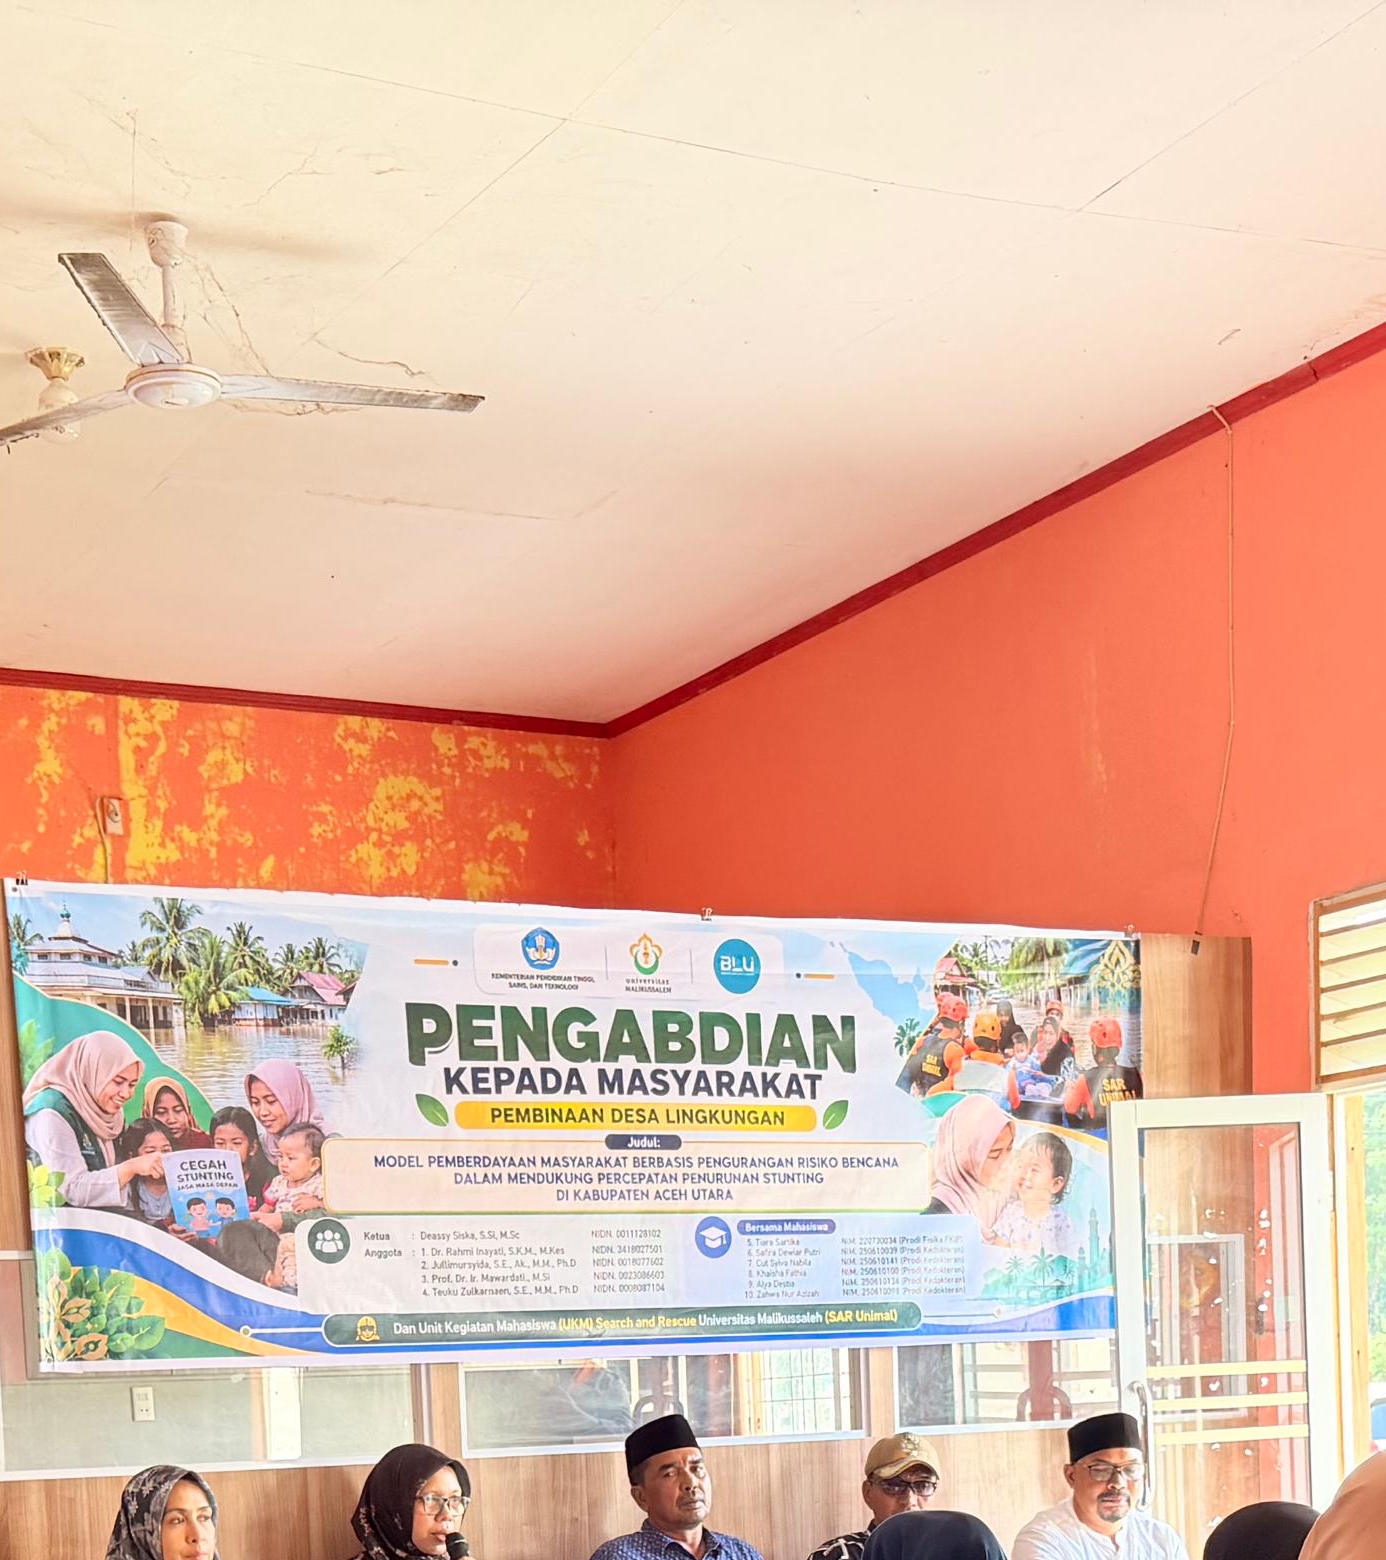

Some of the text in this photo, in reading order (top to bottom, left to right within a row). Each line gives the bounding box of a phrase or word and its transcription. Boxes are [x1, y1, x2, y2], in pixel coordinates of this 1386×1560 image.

[720, 955, 754, 973] BLU
[405, 1002, 857, 1073] PENGABDIAN
[444, 1066, 822, 1099] KEPADA MASYARAKAT
[1103, 1078, 1126, 1091] SAR
[491, 1108, 785, 1125] PEMBINAAN DESA LINGKUNGAN
[627, 1136, 661, 1149] Judul:
[180, 1160, 227, 1171] CEGAH
[374, 1156, 899, 1168] MODEL PEMBERDAYAAN MASYARAKAT BERBASIS PENGURANGAN RISIKO BENCANA
[177, 1172, 234, 1183] STUNTING
[454, 1173, 823, 1184] DALAM MENDUKUNG PERCEPATAN PENURUNAN STUNTING
[557, 1189, 733, 1201] DI KABUPATEN ACEH UTARA
[745, 1223, 828, 1231] Bersama Mahasiswa
[364, 1232, 390, 1241] Ketua
[421, 1231, 450, 1242] Deassy
[365, 1249, 402, 1259] Anggota
[431, 1248, 444, 1257] Dr.
[446, 1248, 474, 1257] Rahmi
[455, 1274, 467, 1283] Dr.
[432, 1288, 458, 1296] Teuku
[394, 1309, 898, 1336] Dan Unit Kegiatan Mahasiswa (UKM) Search and Rescue Universitas Malikussaleh (SAR Unimal)
